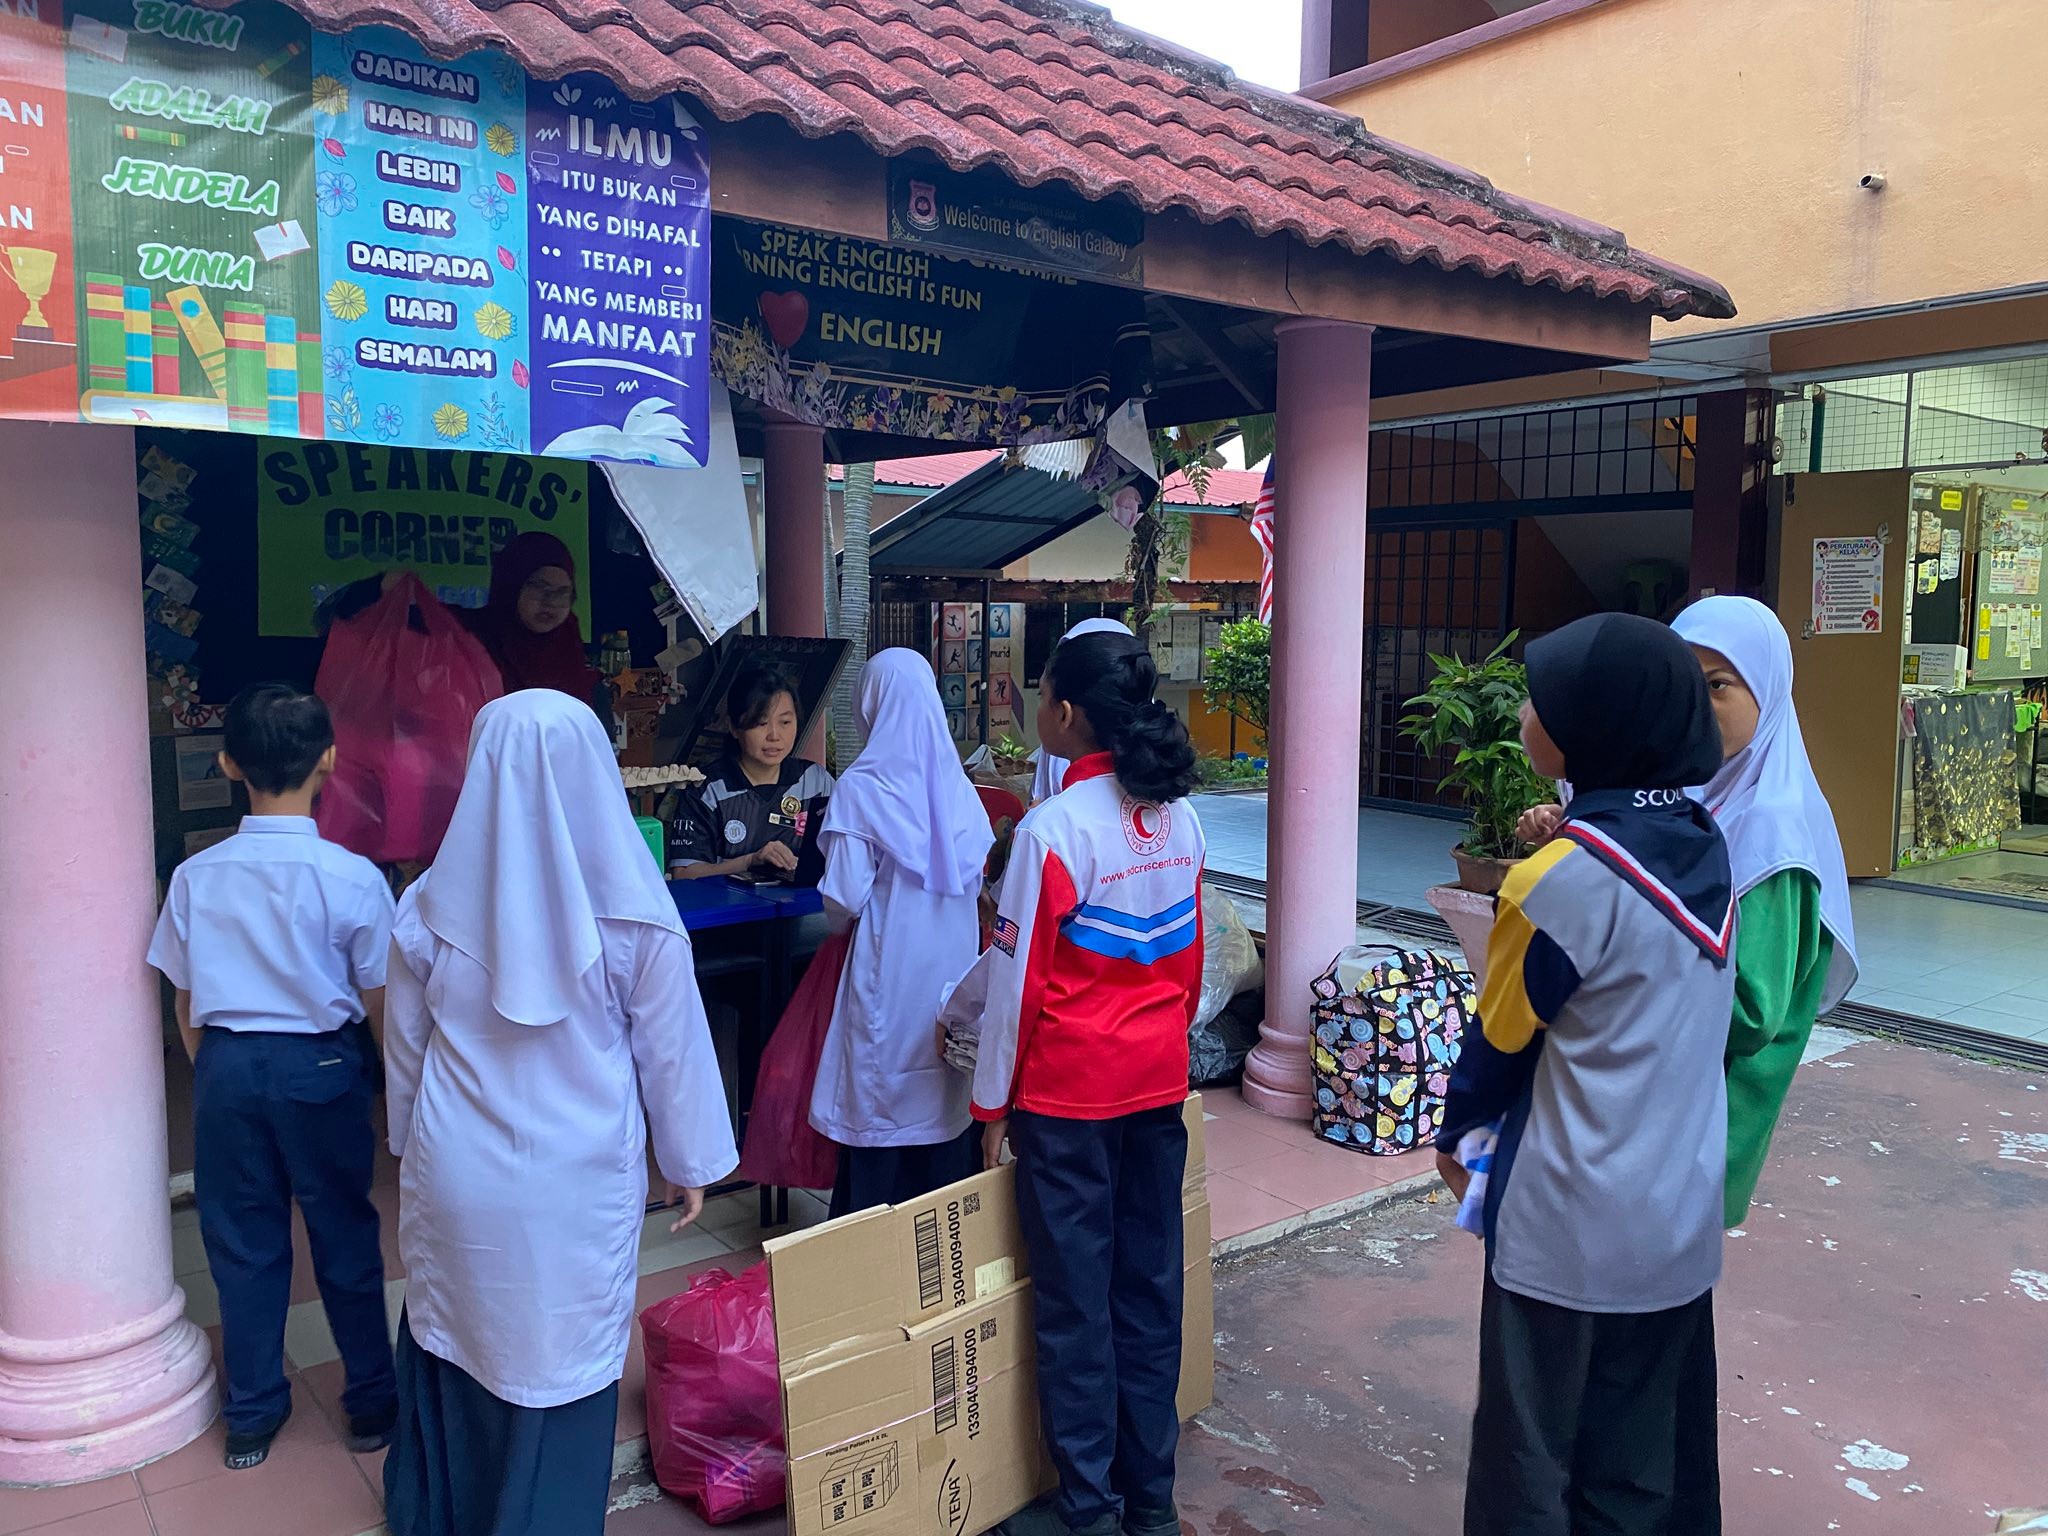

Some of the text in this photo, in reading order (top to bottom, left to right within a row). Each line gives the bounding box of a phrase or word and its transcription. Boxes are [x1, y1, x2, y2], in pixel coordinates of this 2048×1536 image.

[132, 0, 244, 51] BUKU
[356, 53, 474, 95] JADIKAN
[109, 76, 272, 135] ADALAH
[369, 103, 473, 142] HARI INI
[567, 114, 672, 167] ILMU
[102, 156, 279, 216] JENDELA
[381, 154, 456, 185] LEBIH
[563, 170, 676, 207] ITU BUKAN
[0, 205, 33, 231] N
[388, 203, 454, 231] BAIK
[536, 204, 700, 248] YANG DIHAFAL
[944, 204, 1128, 262] Welcome to English Galaxy
[137, 242, 255, 291] DUNIA
[351, 245, 490, 281] DARIPADA
[581, 250, 652, 277] TETAPI
[761, 230, 830, 263] SPEAK
[838, 244, 928, 278] ENGLISH
[536, 281, 702, 321] YANG MEMBERI
[819, 264, 912, 299] ENGLISH
[920, 282, 936, 302] IS
[941, 286, 981, 312] FUN
[389, 298, 452, 323] HARI
[542, 314, 696, 357] MANFAAT
[820, 312, 942, 356] ENGLISH
[360, 341, 492, 371] SEMALAM
[990, 646, 1010, 658] murid
[964, 1328, 980, 1440] 133040094000
[832, 1478, 846, 1499] Tena
[862, 1468, 875, 1488] Tena
[833, 1500, 847, 1521] Tena
[863, 1490, 877, 1510] Tena
[948, 1476, 961, 1528] TENA
